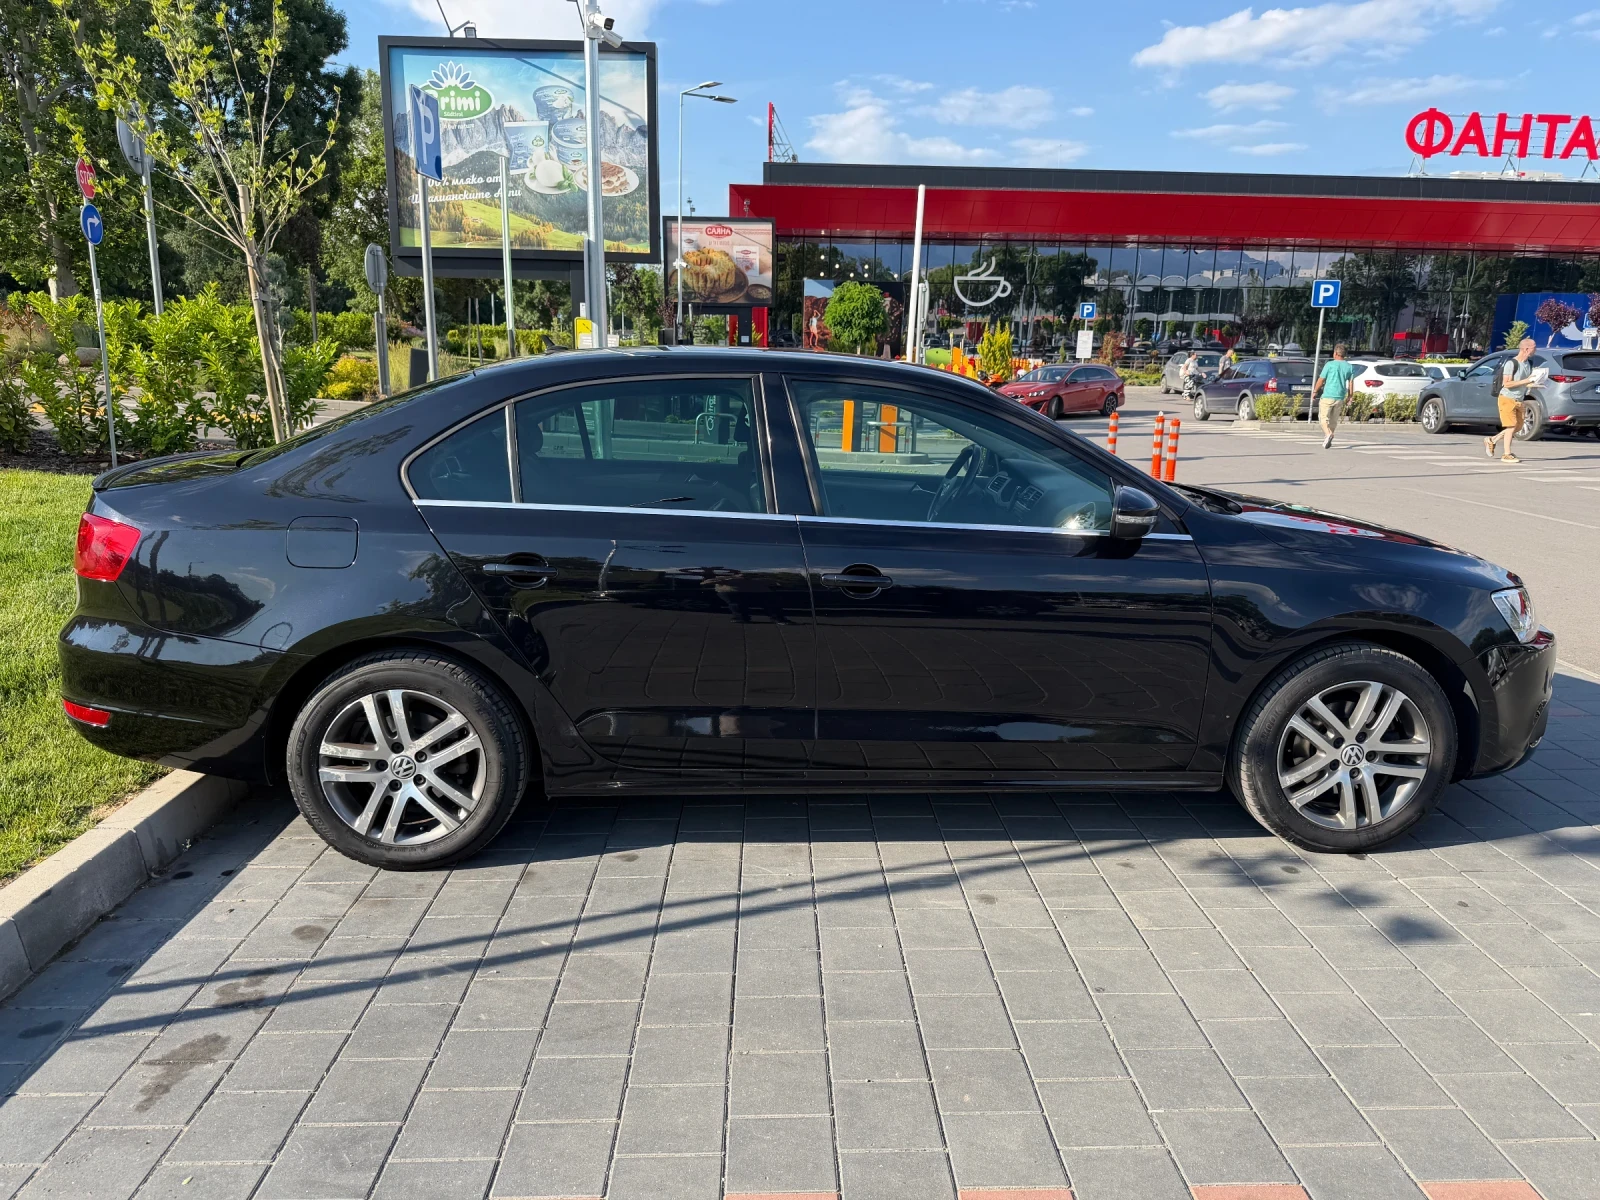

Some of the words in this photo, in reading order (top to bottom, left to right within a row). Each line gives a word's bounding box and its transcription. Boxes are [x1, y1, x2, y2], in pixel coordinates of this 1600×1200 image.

[1405, 107, 1598, 160] ФАНТА
[427, 176, 450, 188] 00%
[451, 173, 485, 185] мляко
[408, 190, 492, 204] Иалианските
[493, 187, 522, 198] Апи
[1318, 284, 1334, 304] P
[1083, 305, 1093, 317] P
